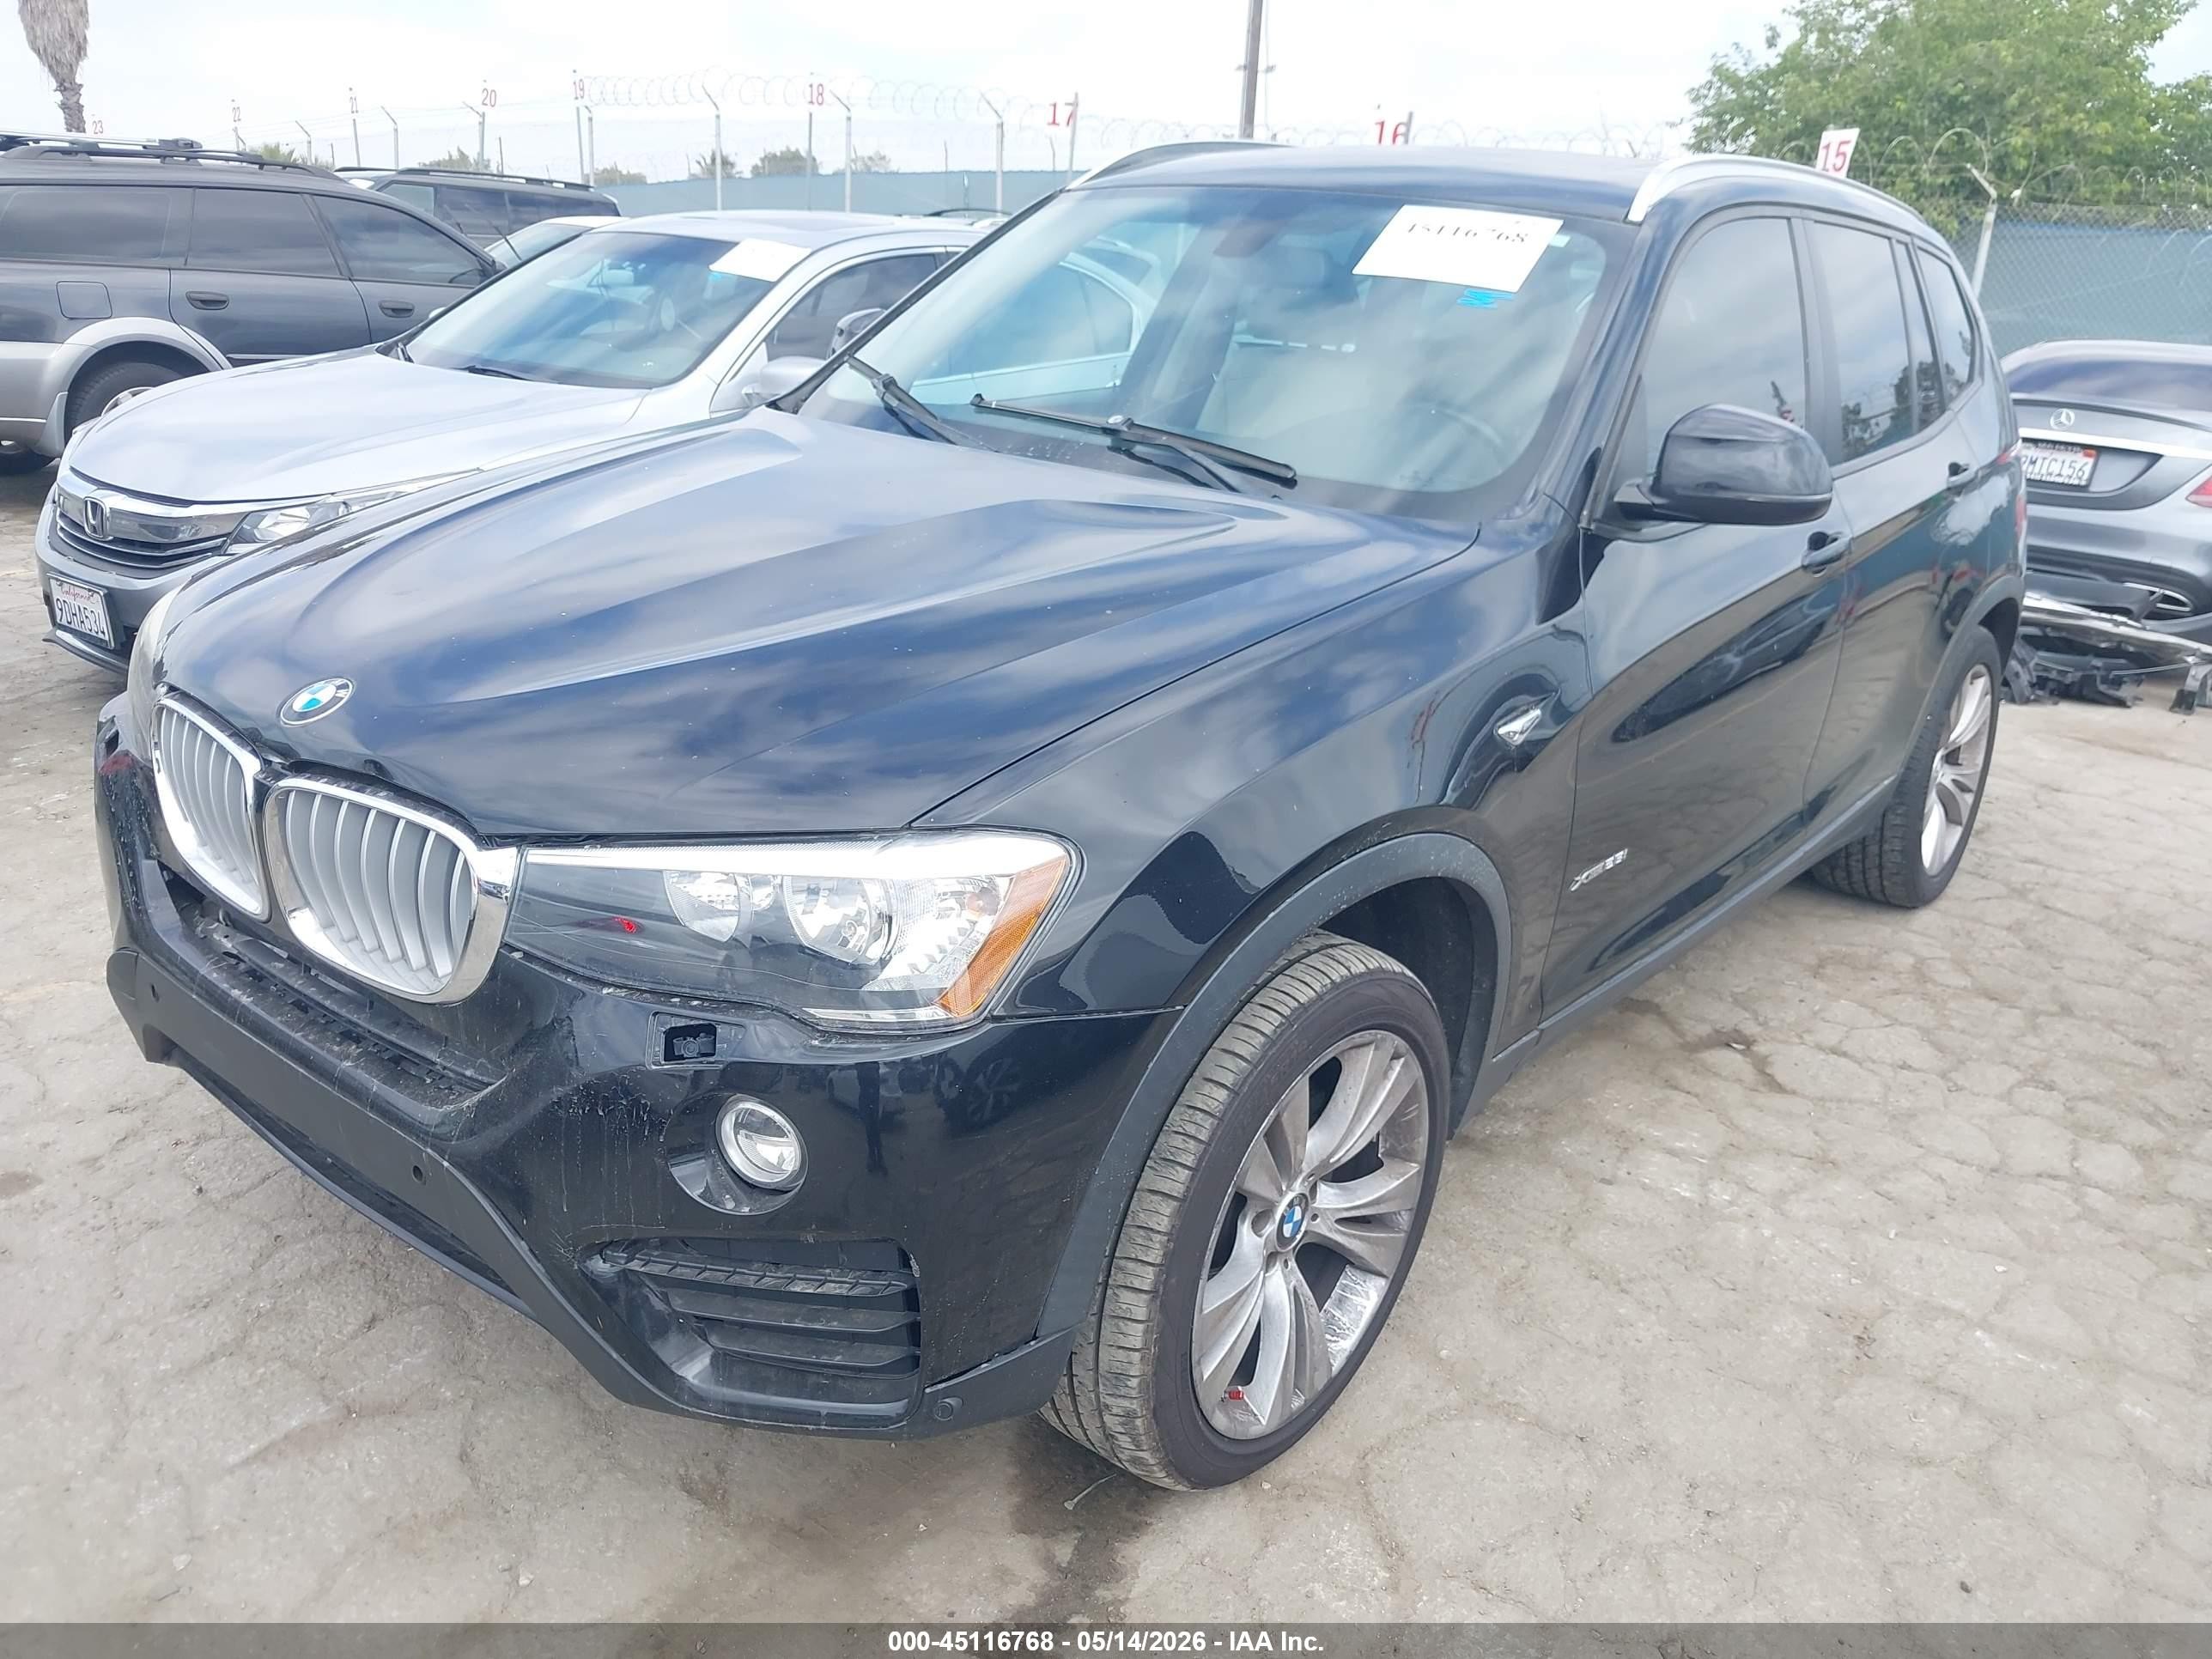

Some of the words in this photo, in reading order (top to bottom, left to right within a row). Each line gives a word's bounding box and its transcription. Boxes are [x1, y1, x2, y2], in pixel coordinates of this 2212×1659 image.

[482, 88, 497, 107] 20
[574, 78, 585, 100] 19
[808, 83, 824, 106] 18
[1047, 101, 1077, 127] 17
[92, 120, 104, 134] 23
[1374, 120, 1408, 145] 16
[1820, 138, 1852, 172] 15
[1406, 221, 1532, 245] 11668
[56, 597, 106, 638] 9DHA534
